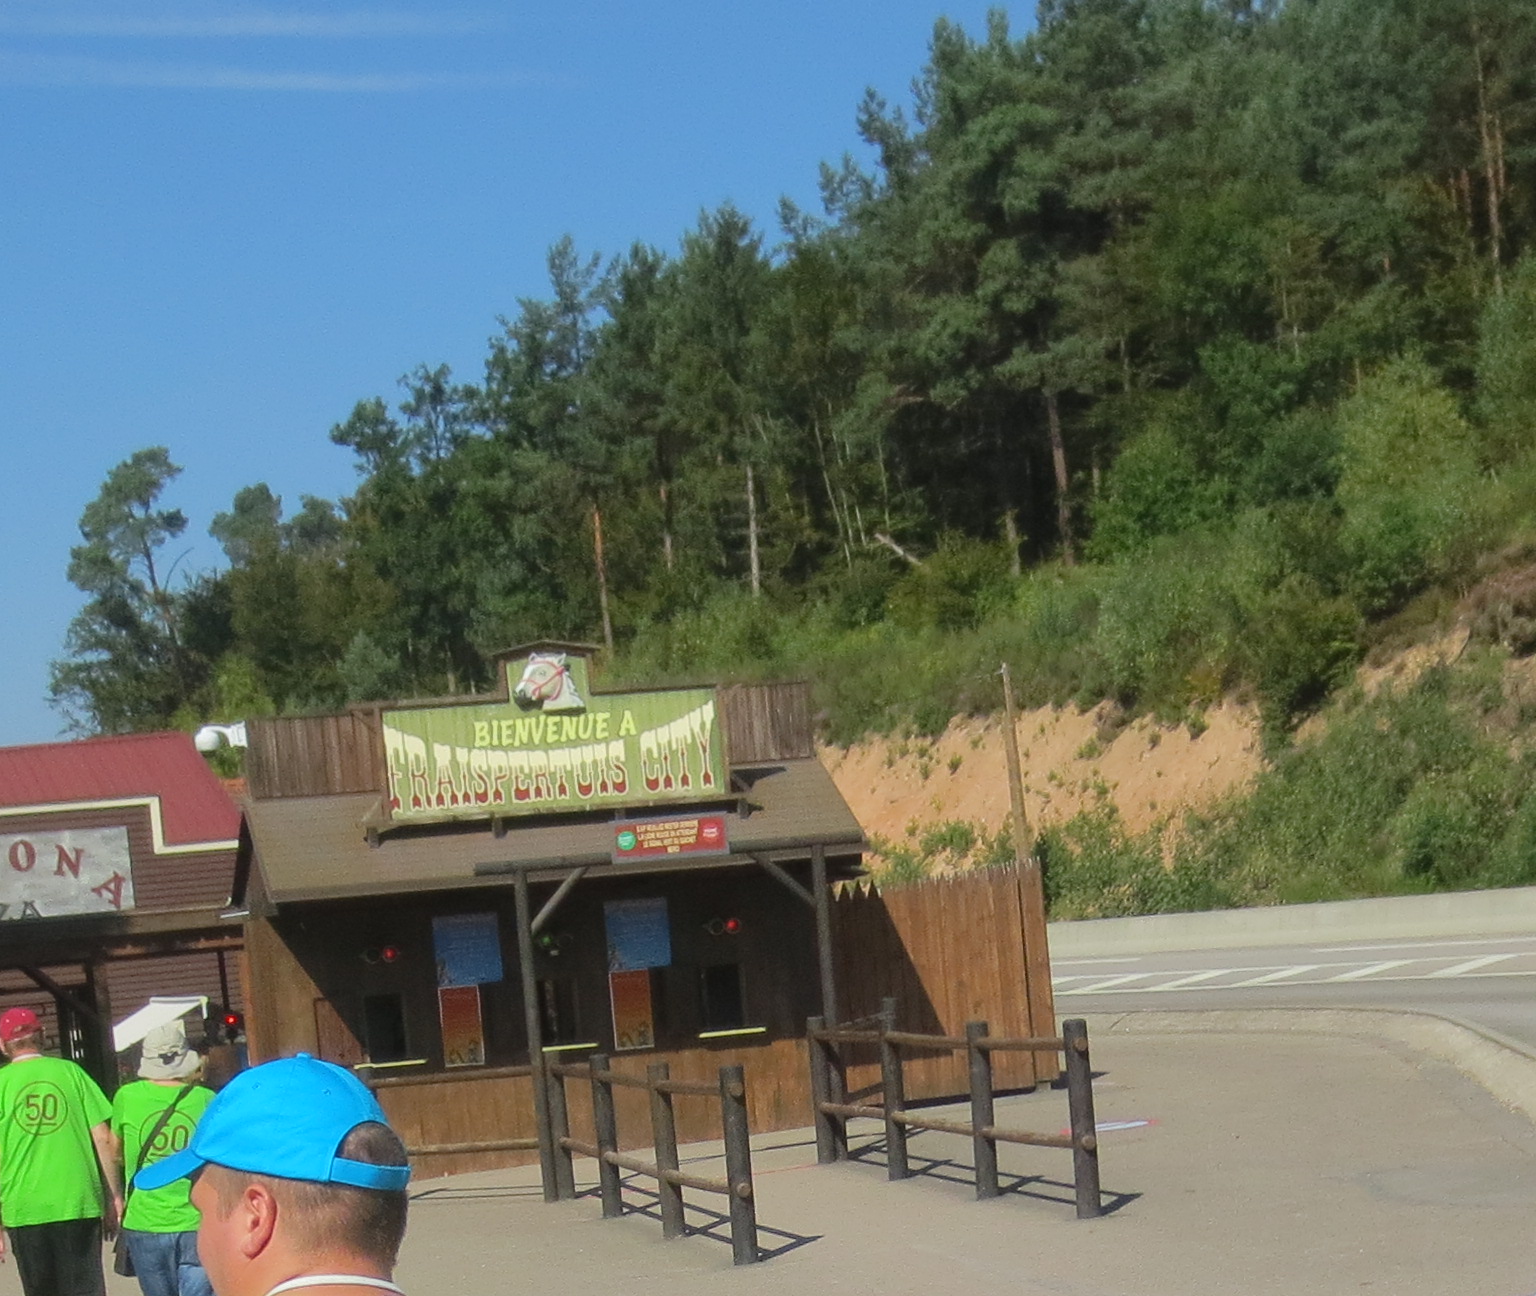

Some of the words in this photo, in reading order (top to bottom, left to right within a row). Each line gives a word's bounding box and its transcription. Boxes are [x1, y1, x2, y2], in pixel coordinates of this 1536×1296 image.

[474, 711, 611, 748] BIENVENUE
[619, 710, 638, 736] A
[383, 724, 628, 814] FRAISPERTUIS
[639, 699, 714, 794] CITY
[25, 1093, 58, 1121] 50
